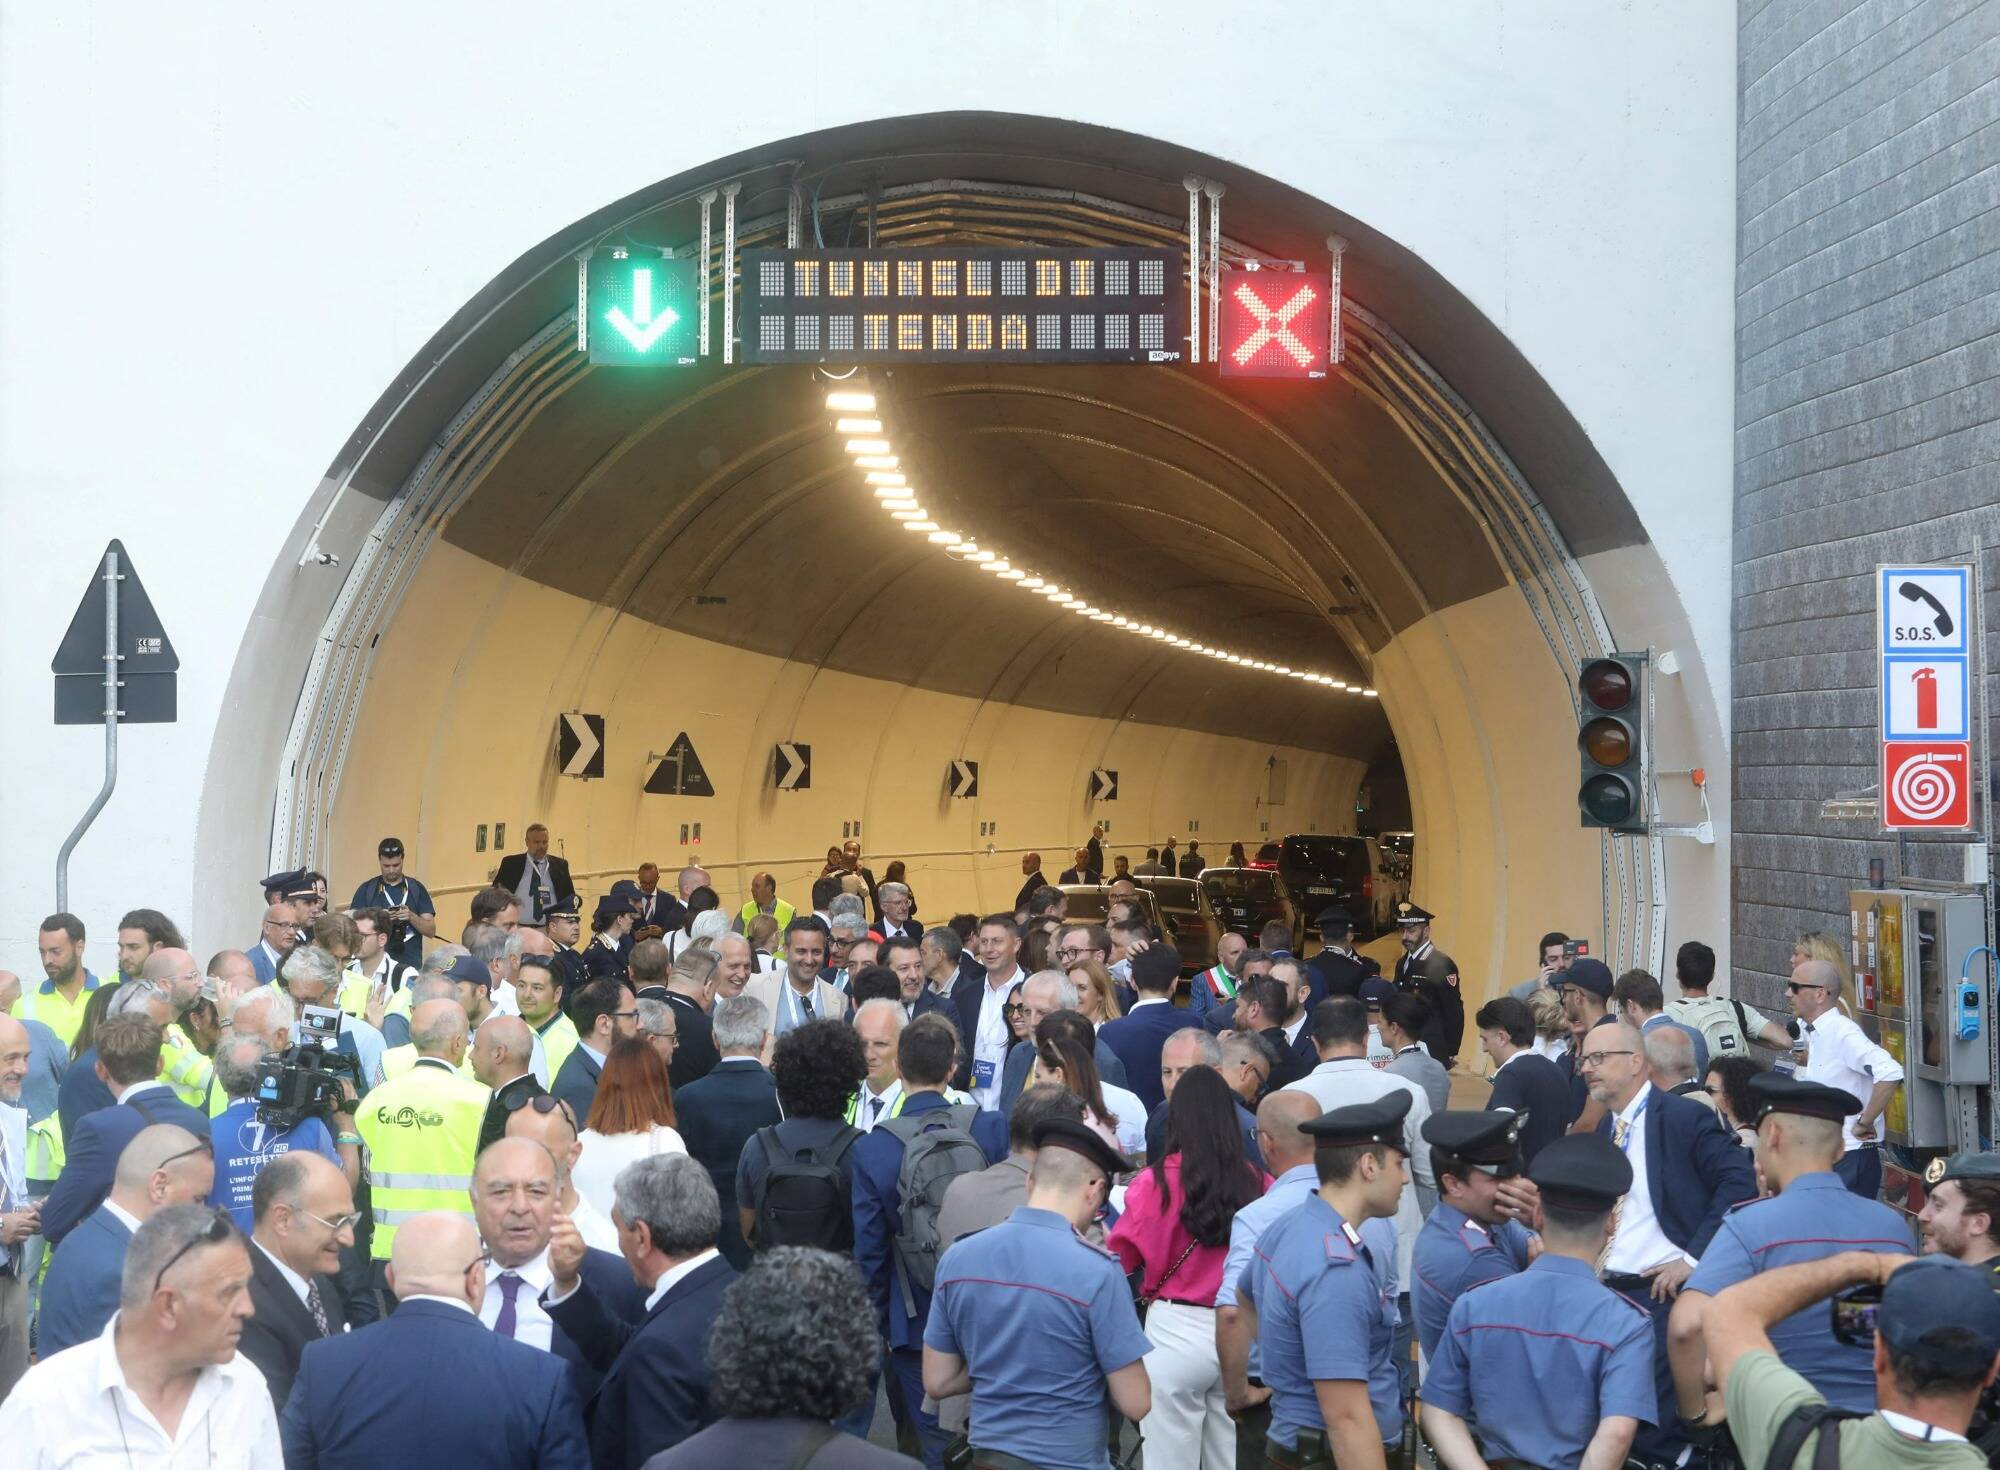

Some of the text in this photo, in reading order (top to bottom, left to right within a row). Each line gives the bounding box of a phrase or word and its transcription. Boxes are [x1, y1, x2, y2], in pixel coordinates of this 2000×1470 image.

[794, 260, 1090, 296] TUNNEL DI
[863, 315, 1027, 350] TENDA
[1150, 352, 1180, 361] aesys
[1895, 627, 1936, 641] S.O.S.
